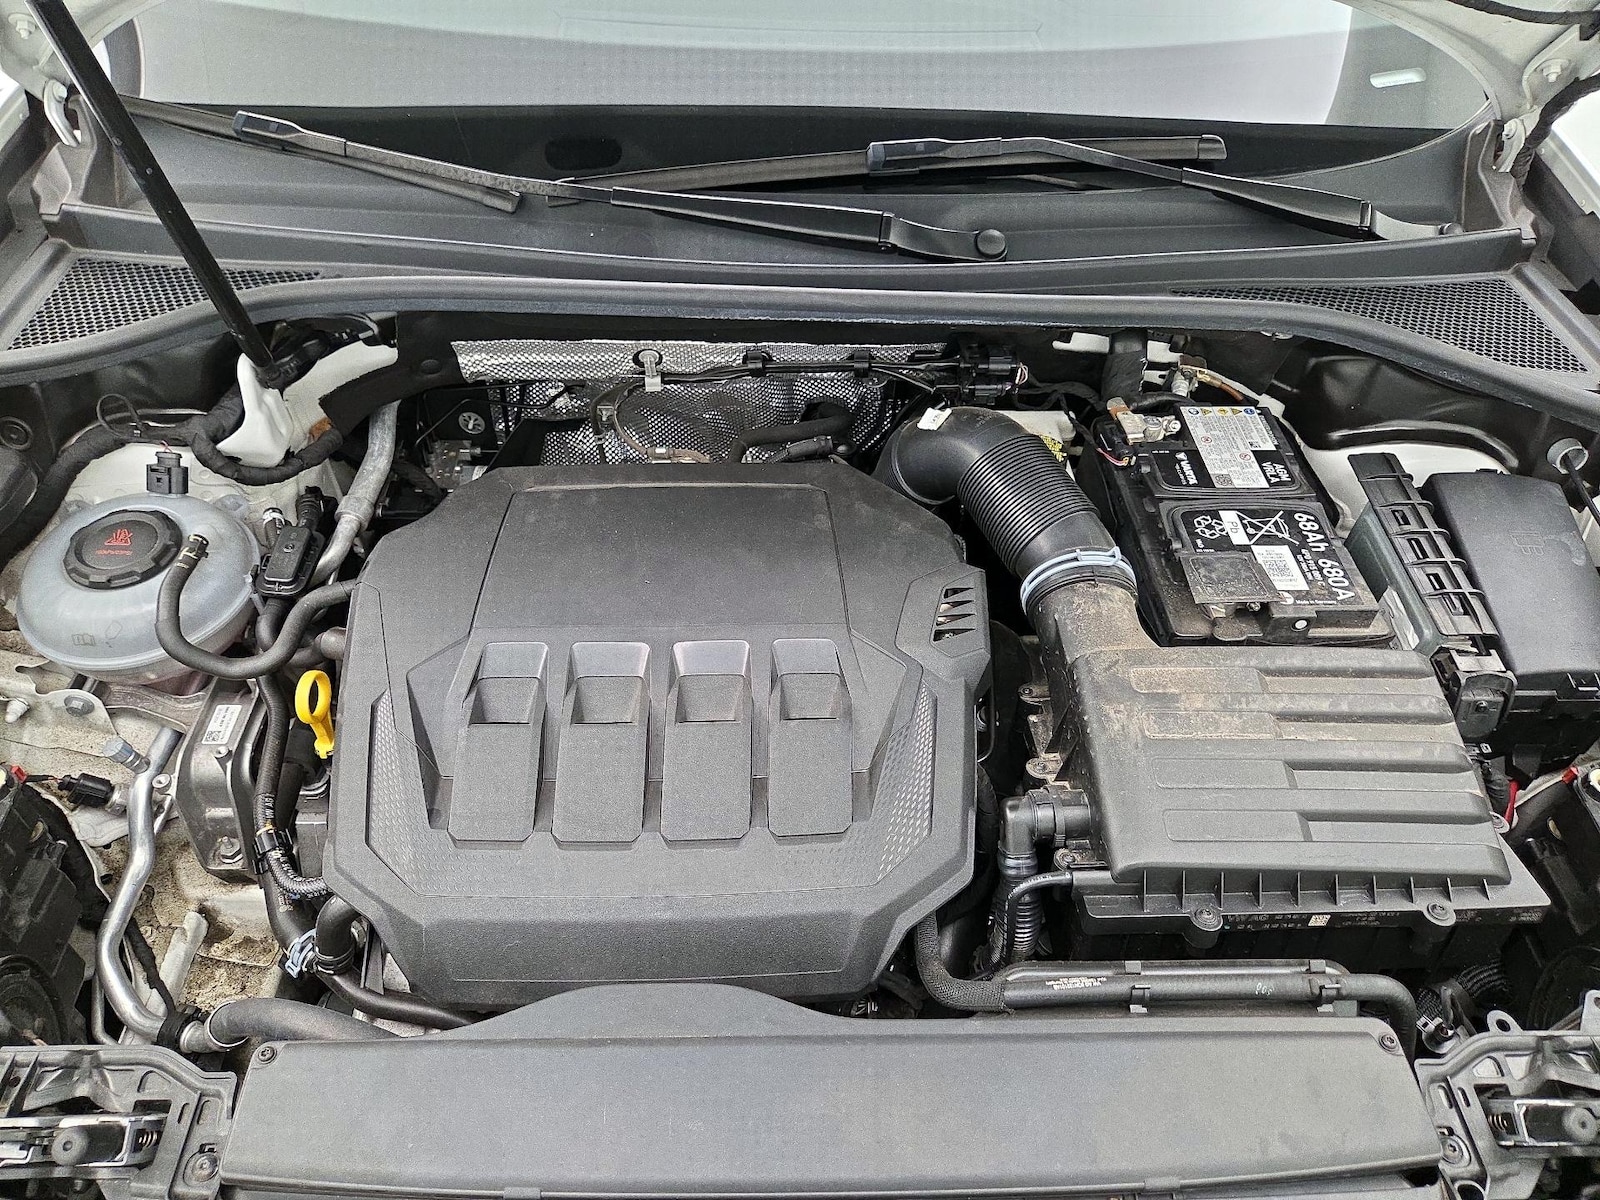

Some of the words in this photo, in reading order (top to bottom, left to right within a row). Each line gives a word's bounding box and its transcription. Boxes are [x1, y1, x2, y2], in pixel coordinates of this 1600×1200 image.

[1180, 460, 1198, 485] VARTA
[1261, 461, 1281, 484] VRLA
[1273, 463, 1291, 481] AGM
[1226, 520, 1239, 534] Pb
[1293, 512, 1330, 552] 68Ah
[1317, 558, 1355, 600] 680A
